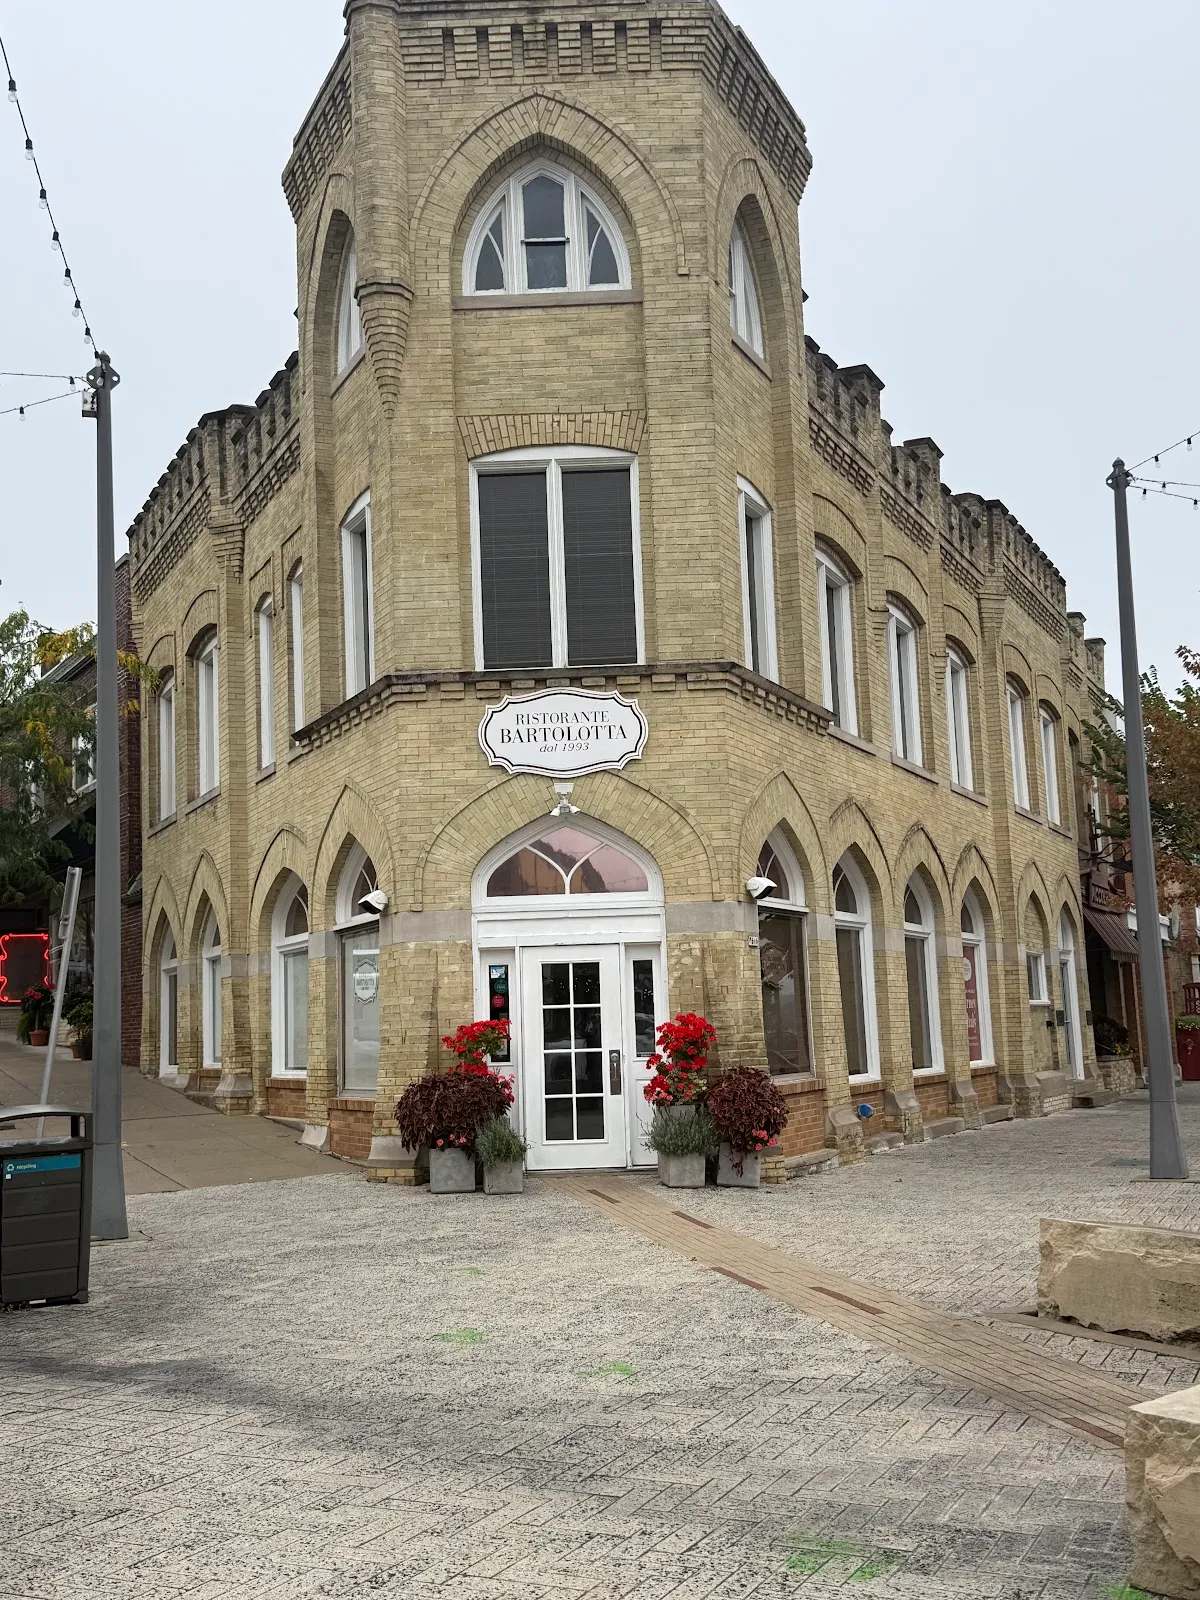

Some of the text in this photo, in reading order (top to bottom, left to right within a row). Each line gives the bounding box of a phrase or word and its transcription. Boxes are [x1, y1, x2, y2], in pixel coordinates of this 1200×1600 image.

[516, 711, 610, 725] RISTORANTE
[500, 724, 627, 744] BARTOLOTTA
[539, 742, 590, 753] dal 1993
